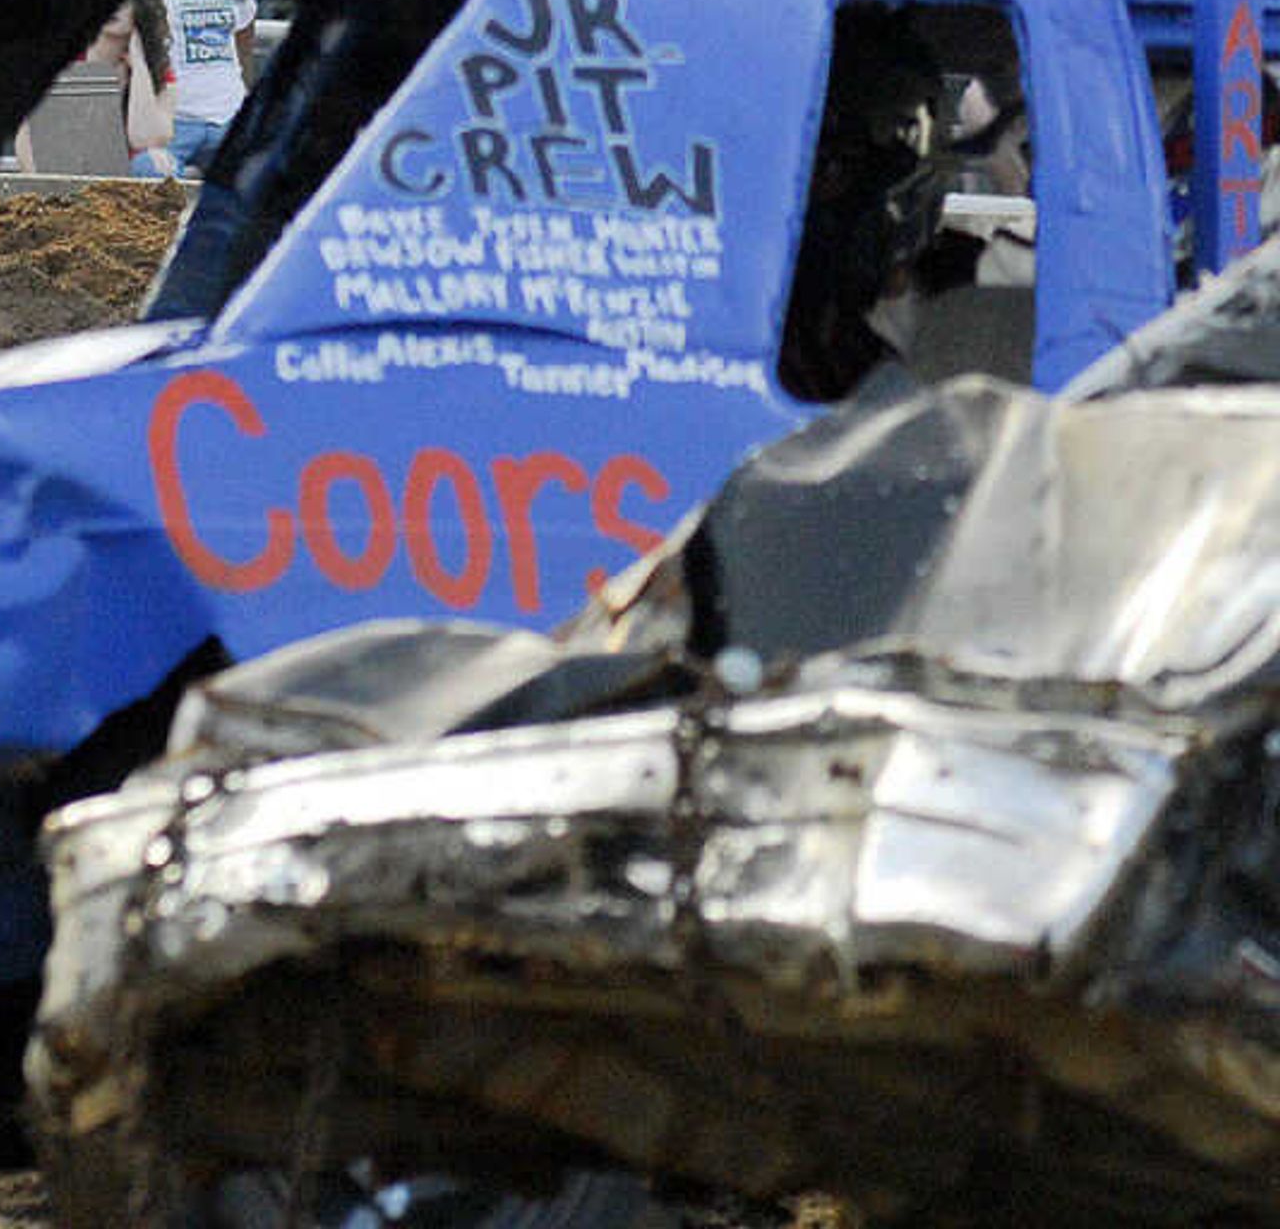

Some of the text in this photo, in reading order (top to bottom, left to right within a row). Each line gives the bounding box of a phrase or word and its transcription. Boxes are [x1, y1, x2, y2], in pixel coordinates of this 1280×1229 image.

[458, 54, 648, 135] PIT
[379, 126, 716, 219] CREW
[335, 272, 510, 316] MALLORY
[148, 371, 670, 613] Coors
